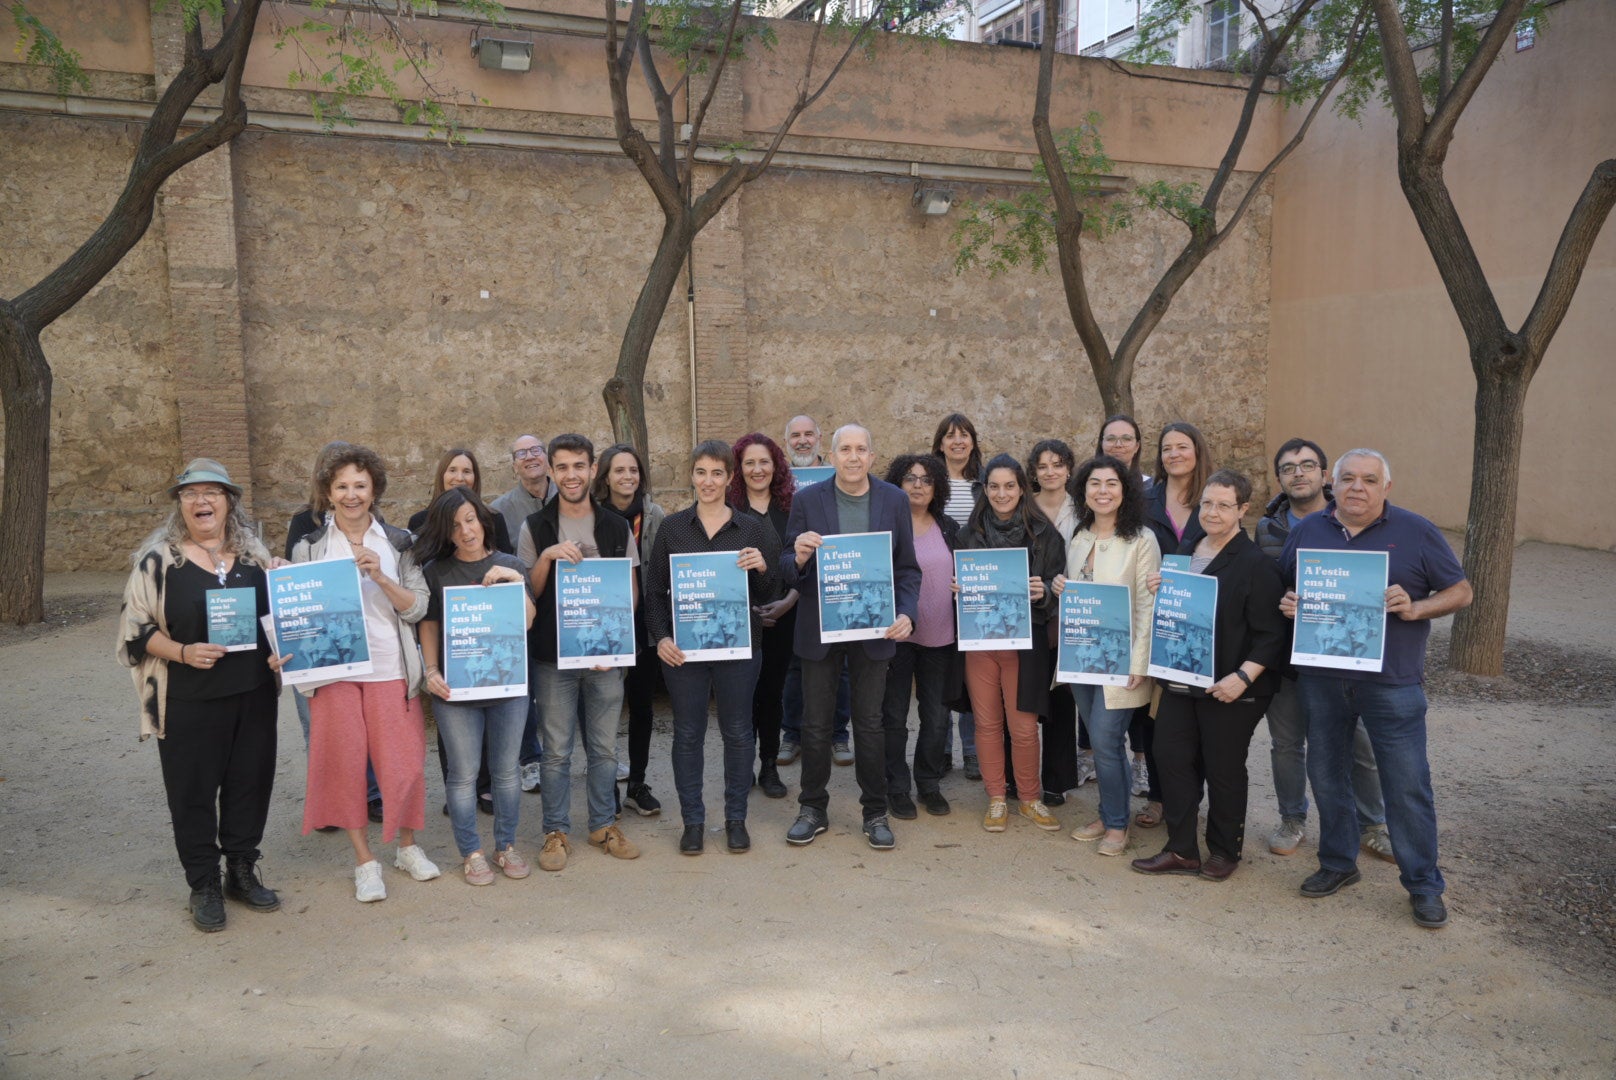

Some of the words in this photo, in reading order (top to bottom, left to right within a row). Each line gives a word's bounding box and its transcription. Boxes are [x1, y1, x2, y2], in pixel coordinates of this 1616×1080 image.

[833, 551, 861, 559] l'estiu
[1316, 567, 1350, 576] l'estiu
[824, 573, 860, 583] juguem
[1326, 579, 1336, 587] hi
[288, 579, 322, 591] l'estiu
[962, 585, 997, 593] juguem
[678, 592, 714, 601] juguem
[1169, 586, 1191, 597] l'estiu
[1303, 590, 1345, 600] juguem
[278, 595, 297, 603] ens
[300, 592, 312, 601] hi
[563, 598, 599, 607] juguem
[1174, 598, 1181, 607] hi
[278, 604, 323, 618] juguem
[462, 602, 492, 611] l'estiu
[1158, 607, 1186, 619] juguem
[281, 617, 308, 628] molt
[1065, 616, 1099, 625] juguem
[1157, 618, 1175, 628] molt
[452, 626, 490, 636] juguem
